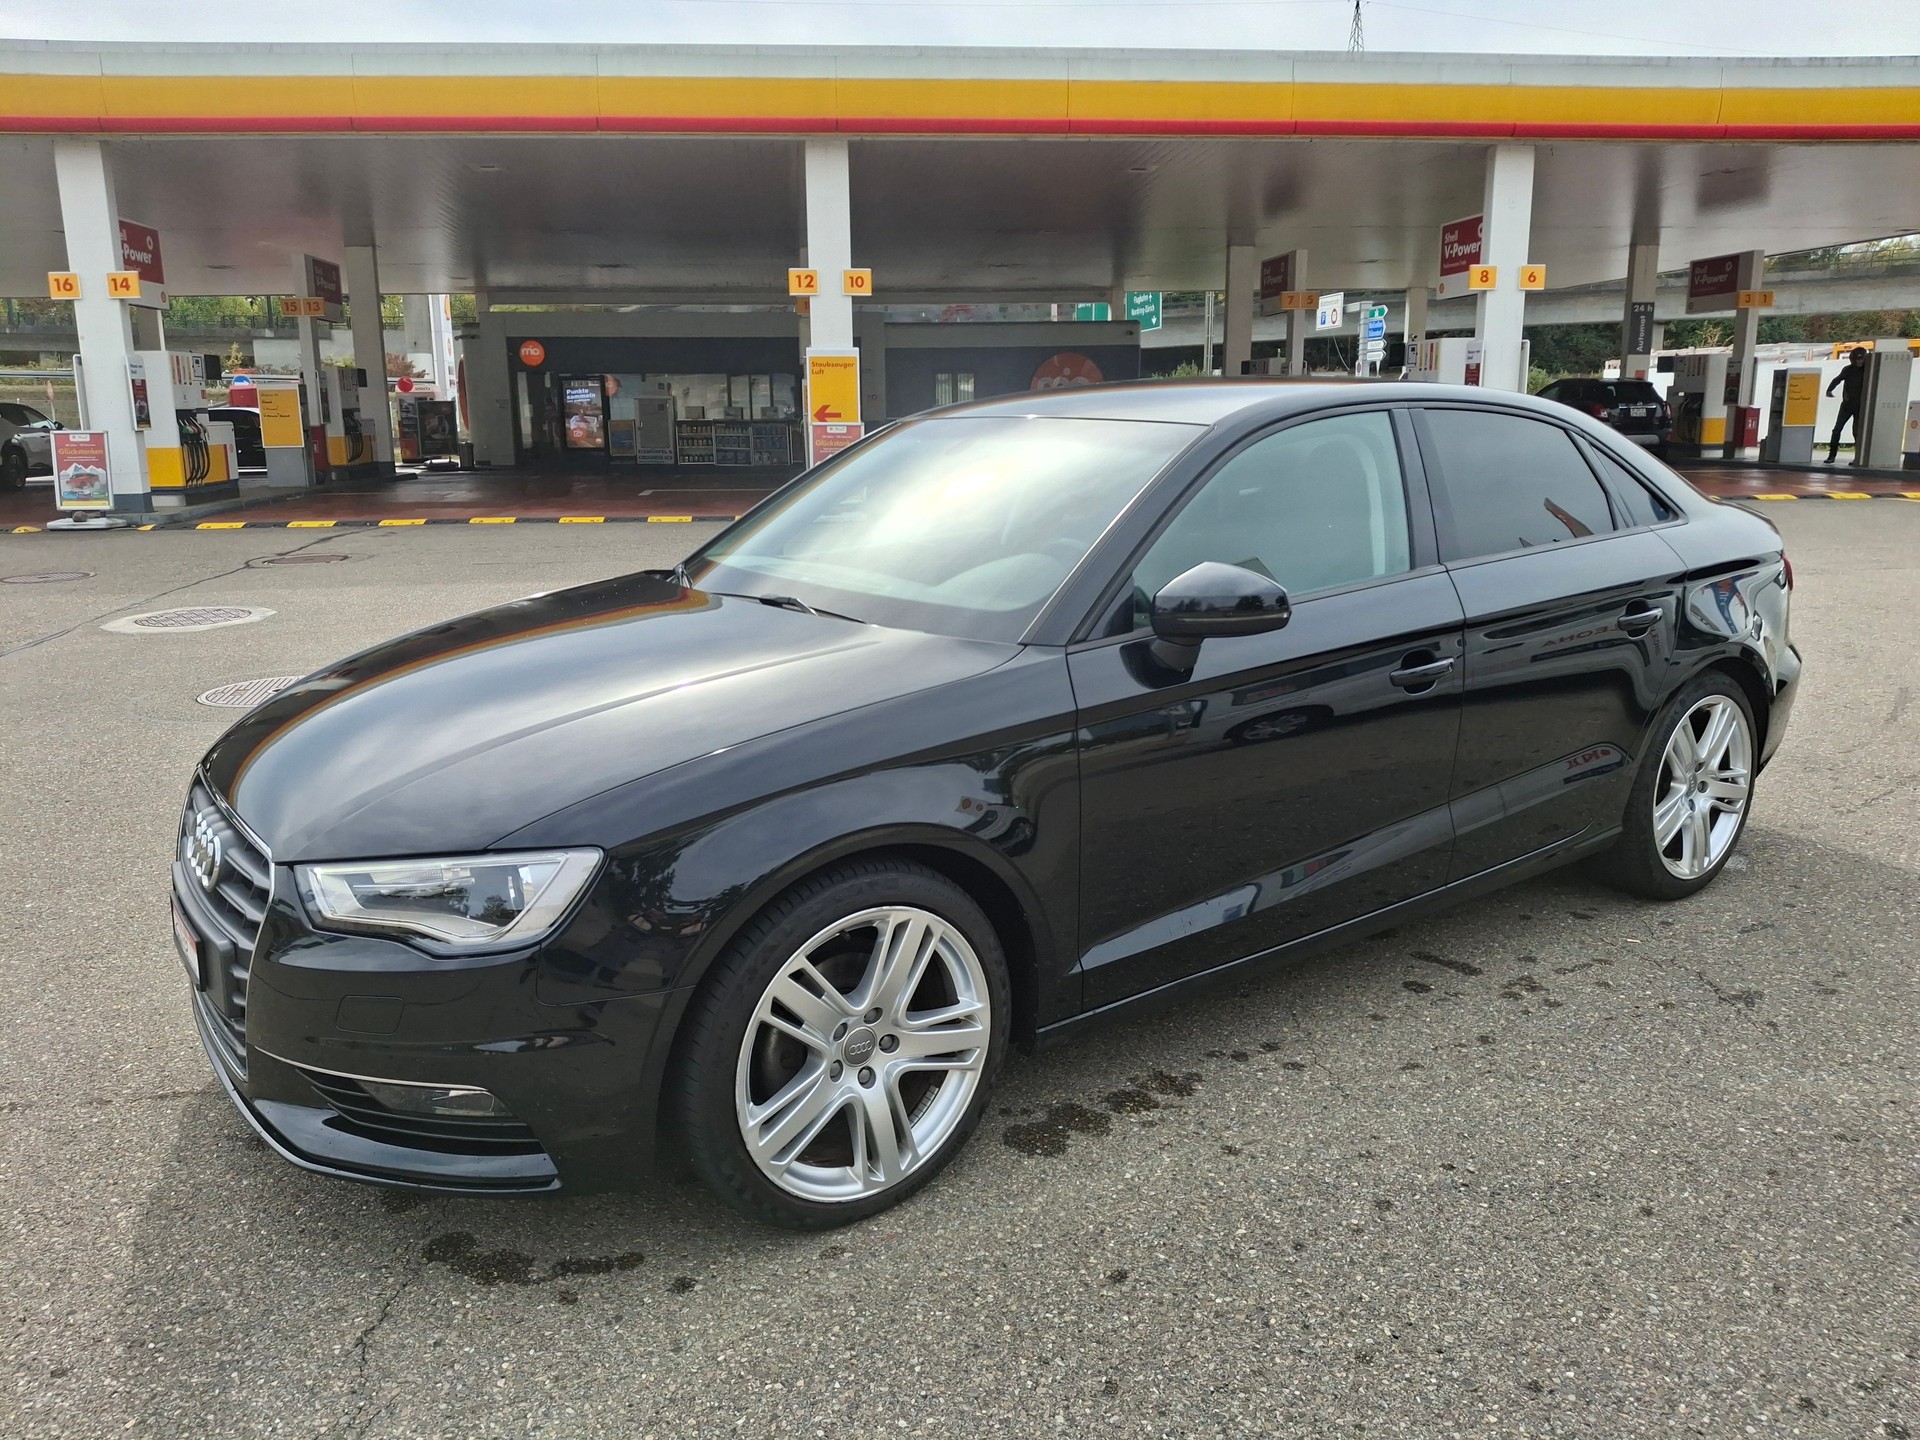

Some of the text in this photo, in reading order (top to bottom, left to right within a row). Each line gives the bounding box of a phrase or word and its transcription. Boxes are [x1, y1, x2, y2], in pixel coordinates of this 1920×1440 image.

[1444, 230, 1458, 243] Shell
[121, 243, 152, 264] -Power
[1444, 241, 1481, 259] V-Power
[796, 274, 814, 288] 12
[849, 276, 864, 288] 10
[1480, 270, 1489, 283] 8
[1528, 272, 1537, 283] 6
[1694, 273, 1729, 286] V-Power
[53, 278, 74, 292] 16
[111, 277, 131, 291] 14
[1287, 295, 1294, 305] 7
[1307, 295, 1314, 304] 5
[1745, 294, 1751, 303] 3
[1763, 294, 1767, 303] 1
[284, 302, 297, 312] 15
[306, 302, 320, 311] 13
[1634, 304, 1645, 312] 24
[1636, 315, 1646, 352] Automat
[811, 361, 855, 369] Staubsauger
[566, 388, 589, 396] Punkte
